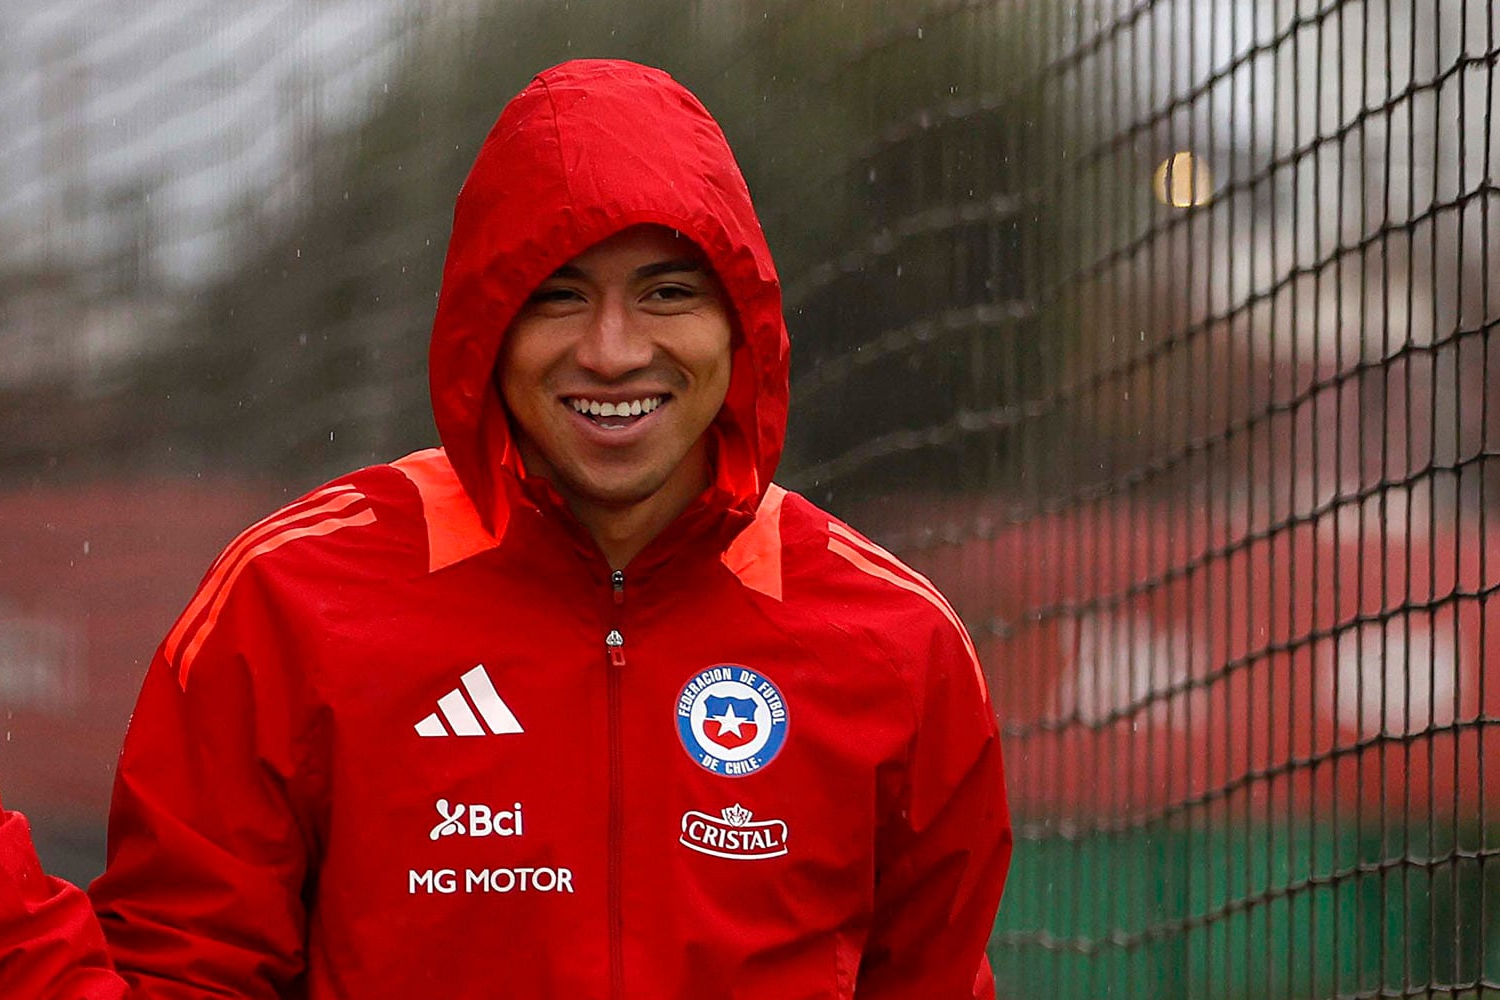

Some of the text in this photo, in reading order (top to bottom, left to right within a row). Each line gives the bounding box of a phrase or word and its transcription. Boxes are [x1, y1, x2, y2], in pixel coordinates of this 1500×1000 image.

[678, 668, 786, 725] FEDERACION DE FUTBOL
[702, 755, 760, 775] DE CHILE
[470, 803, 523, 837] Bci
[689, 820, 779, 851] CRISTAL
[408, 867, 574, 894] MG MOTOR
